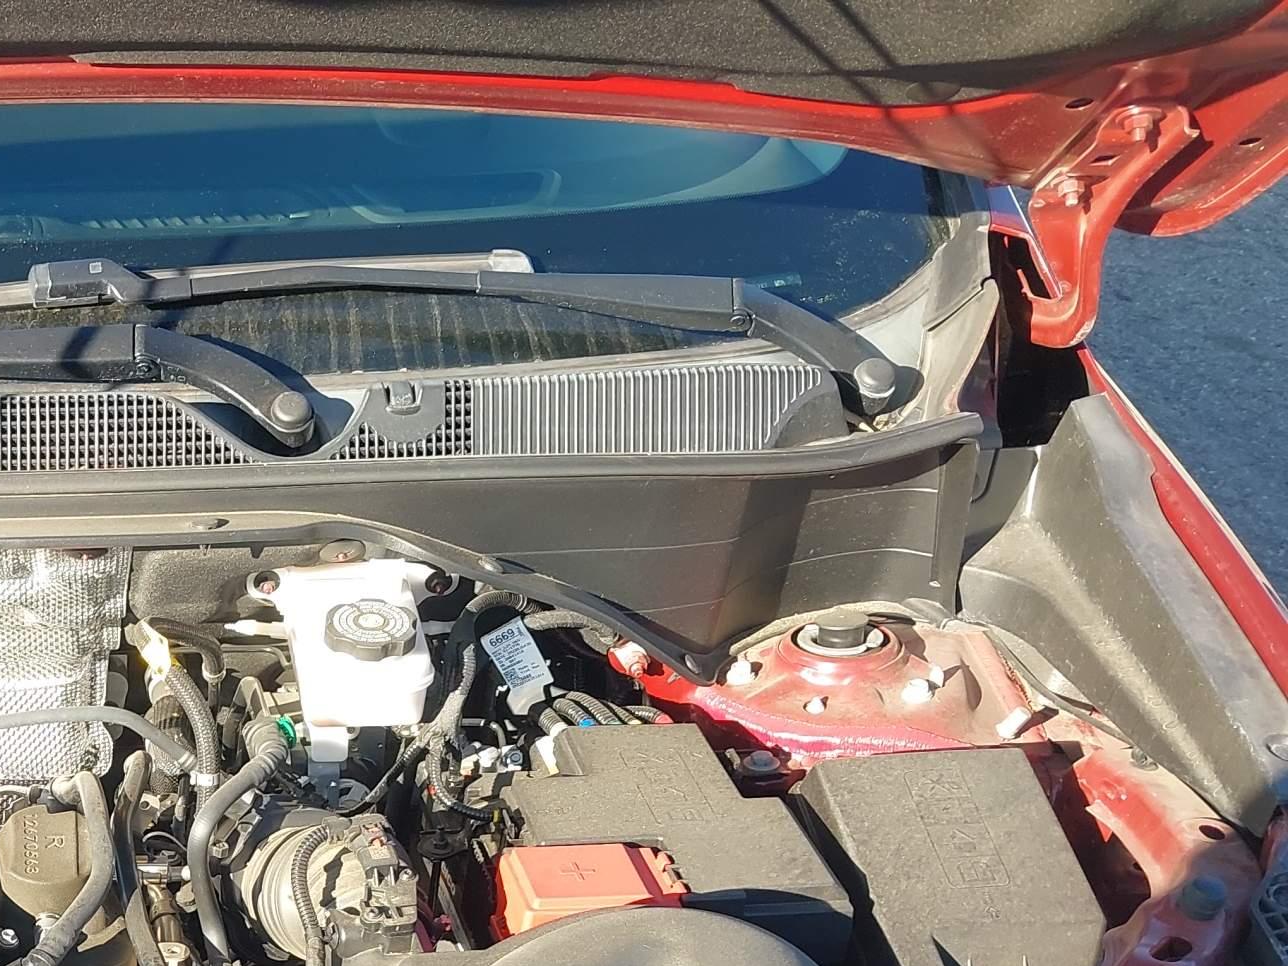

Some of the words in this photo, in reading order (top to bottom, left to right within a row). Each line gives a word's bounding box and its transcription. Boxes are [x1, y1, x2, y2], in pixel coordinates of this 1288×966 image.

[489, 628, 515, 647] 6669
[23, 813, 39, 874] 12670563
[44, 835, 65, 849] R
